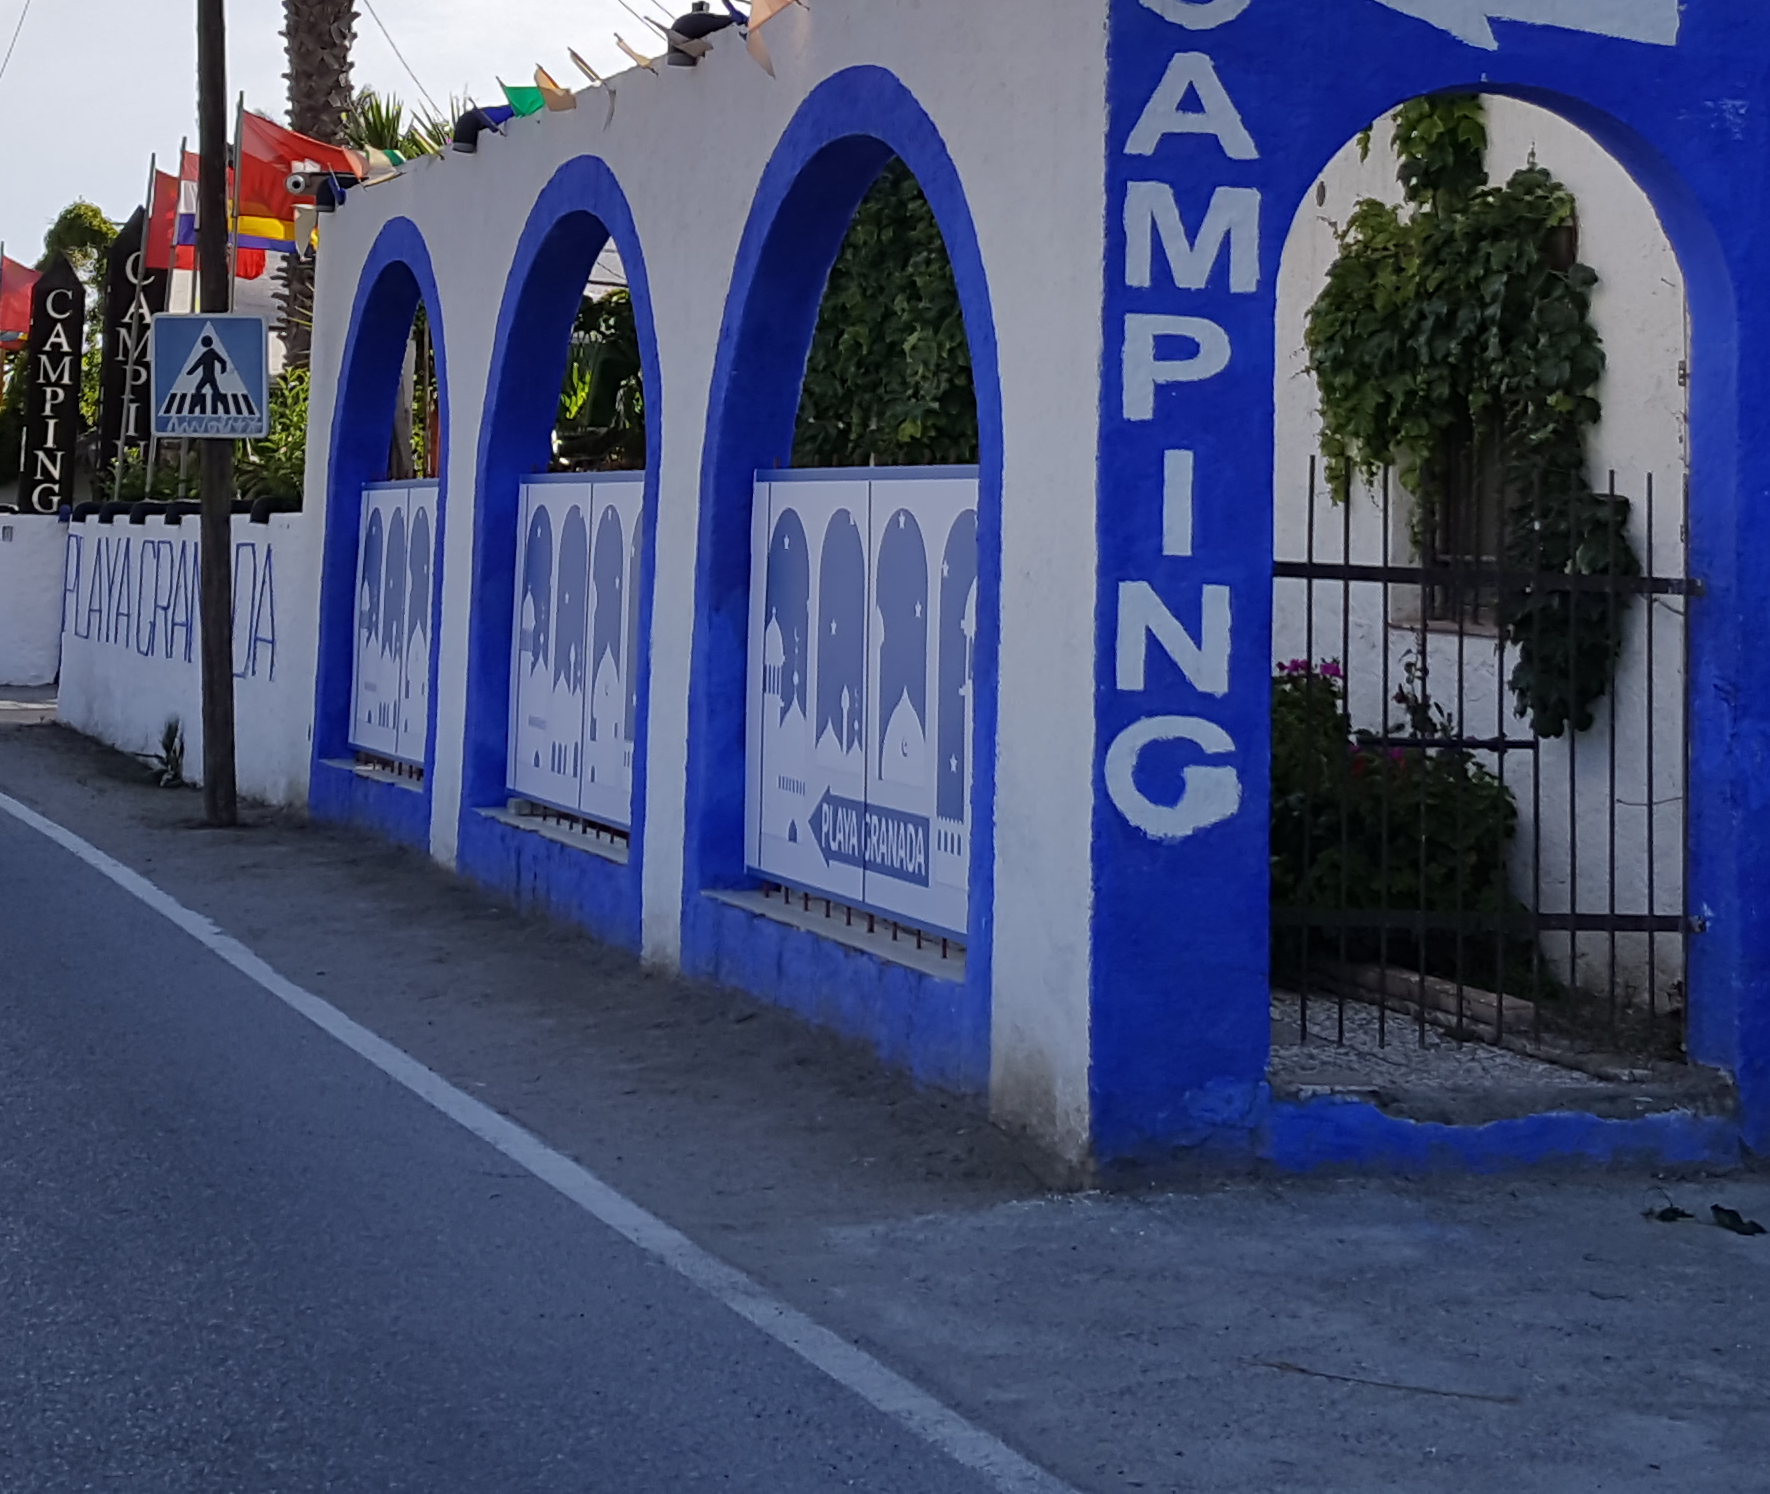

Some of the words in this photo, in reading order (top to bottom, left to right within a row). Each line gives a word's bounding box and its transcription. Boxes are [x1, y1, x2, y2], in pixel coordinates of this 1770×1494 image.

[32, 288, 74, 513] CAMPING
[115, 251, 156, 456] CAMPI
[62, 533, 131, 649] PLAYA
[136, 539, 276, 682] GRANDA
[821, 802, 859, 858] PLAYA
[860, 812, 926, 877] GRANADA
